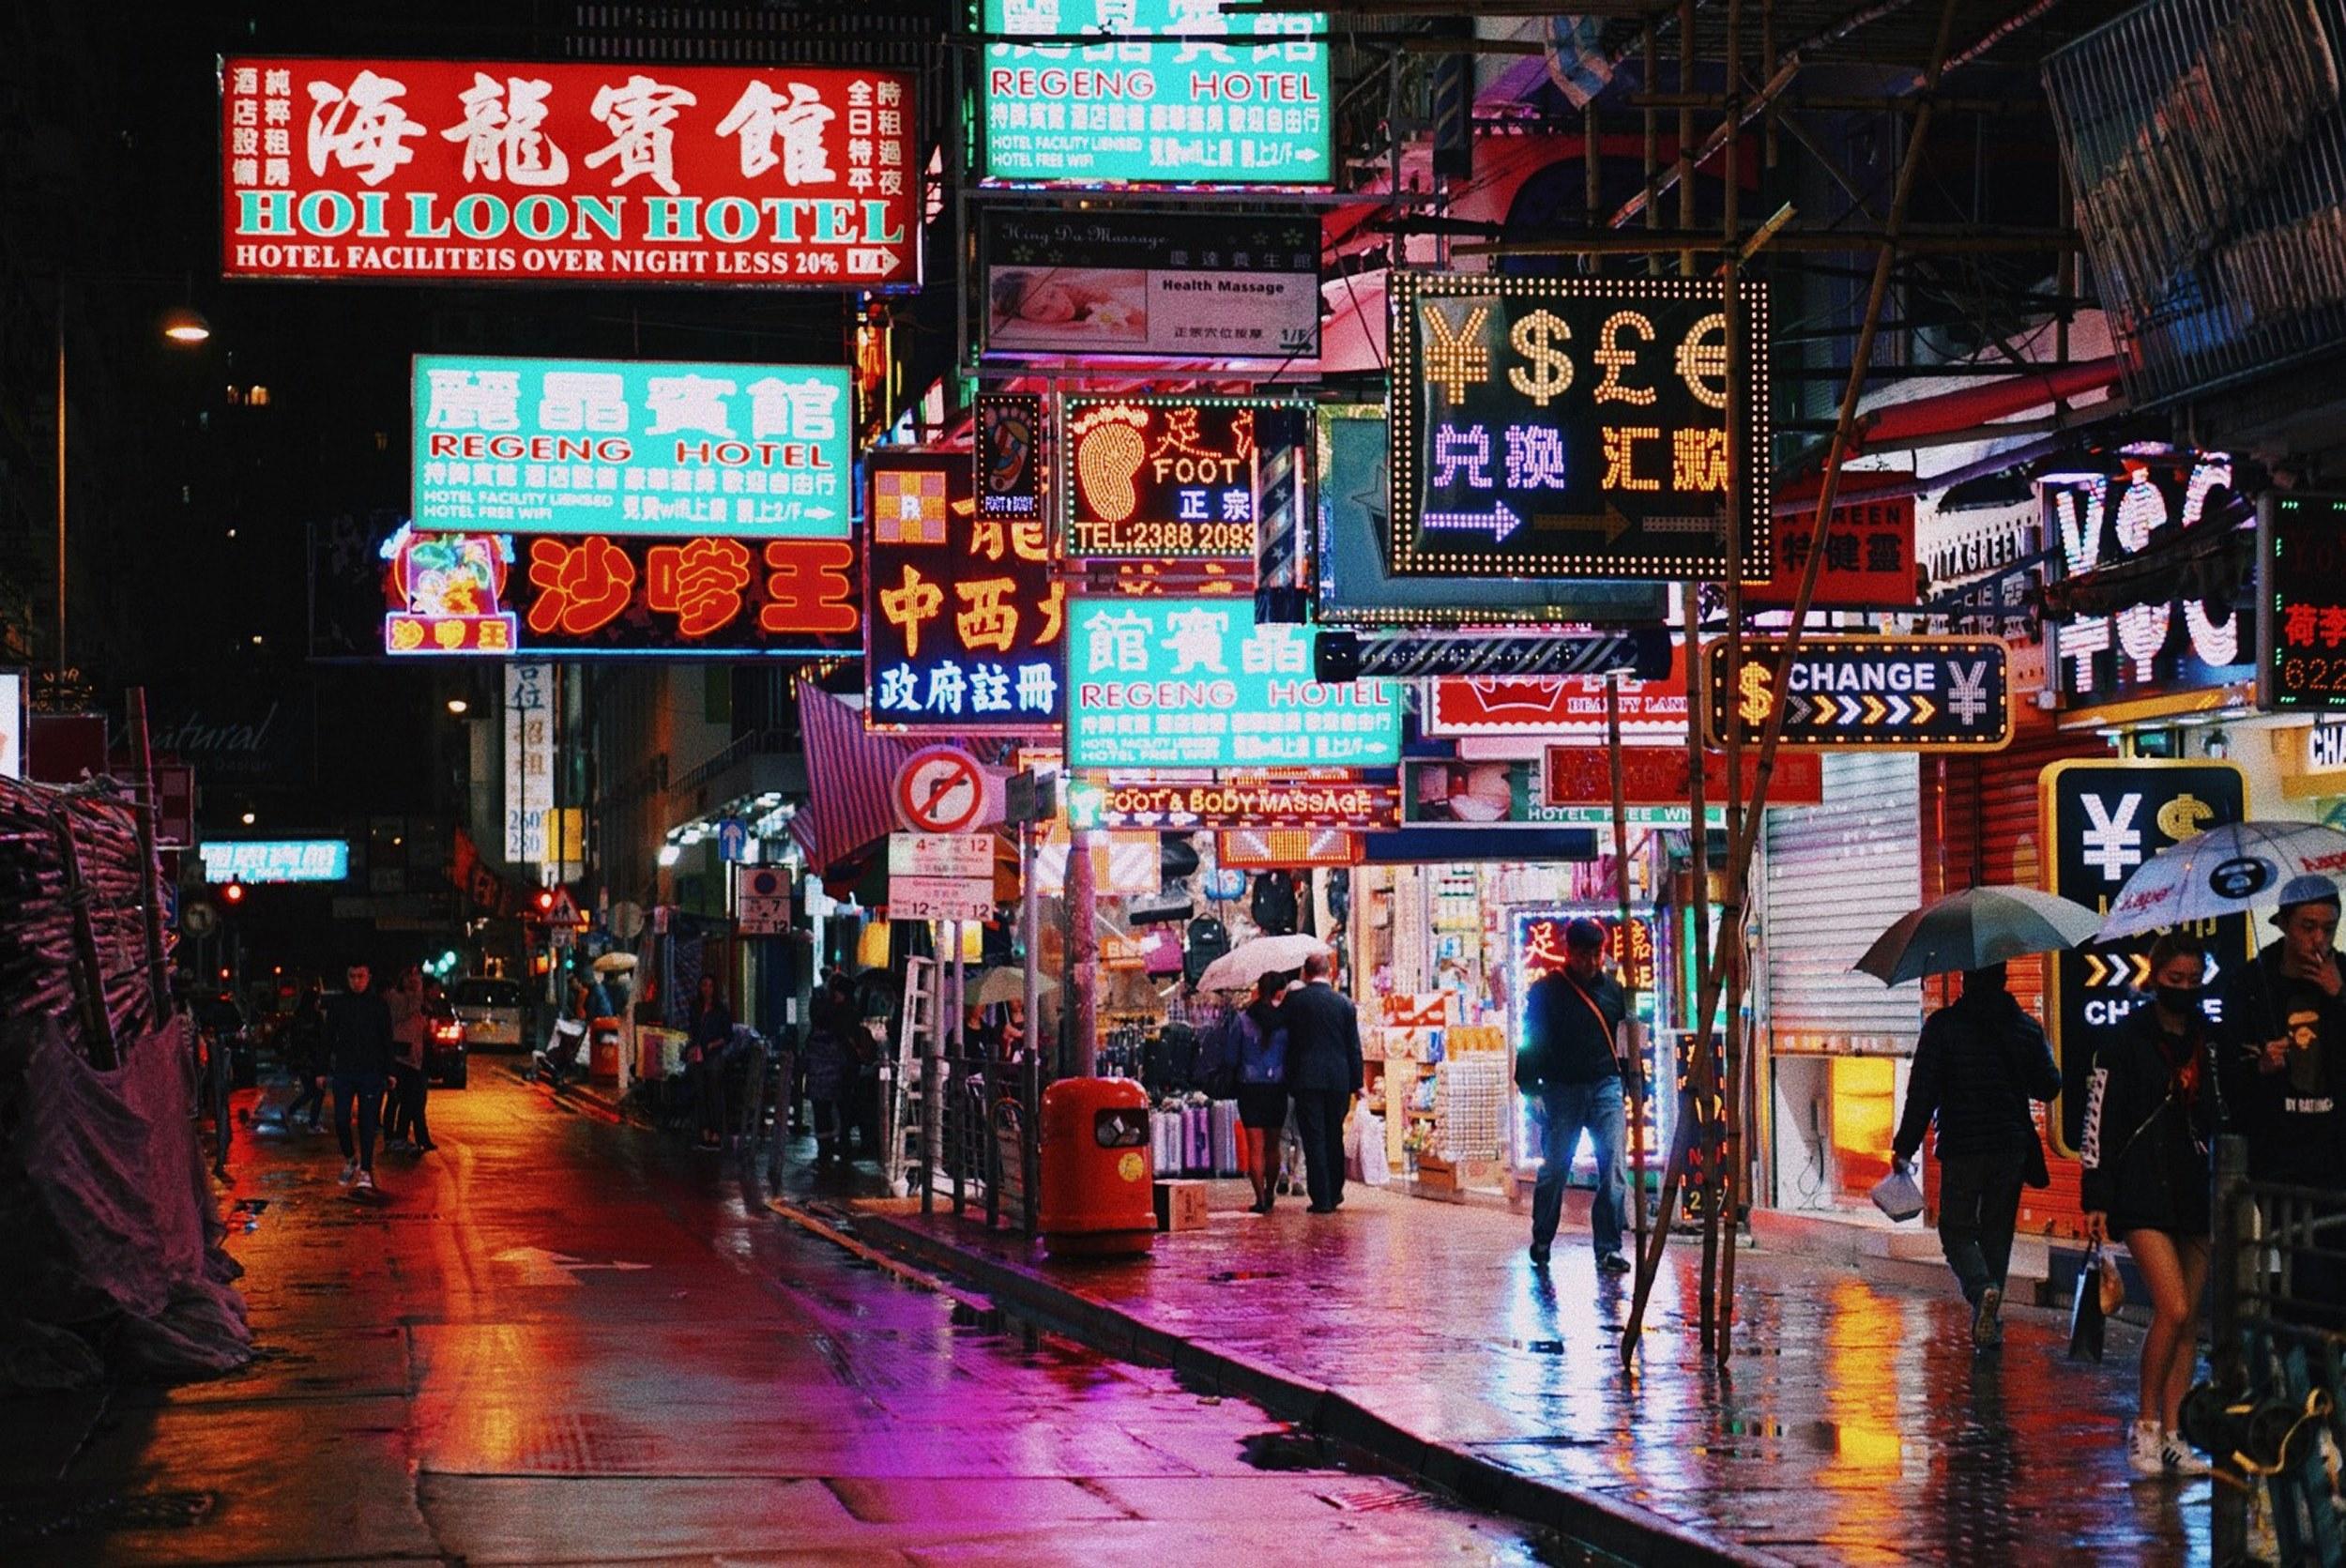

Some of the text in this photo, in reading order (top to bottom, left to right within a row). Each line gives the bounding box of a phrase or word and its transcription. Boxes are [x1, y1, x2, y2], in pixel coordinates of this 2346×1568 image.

[990, 69, 1319, 101] REGENG HOTEL
[307, 69, 837, 194] 海龍賓館
[992, 137, 1032, 151] HOTEL
[992, 154, 1032, 167] HOTEL
[236, 190, 905, 244] HOI LOON HOTEL
[236, 245, 340, 268] HOTEL
[346, 246, 515, 271] FACILITEIS
[523, 249, 604, 272] OVER
[612, 250, 708, 273] NIGHT
[716, 251, 789, 273] LESS
[796, 252, 838, 274] 20%
[1163, 279, 1285, 295] Health Massage
[429, 433, 833, 469] REGENG HOTEL
[1153, 458, 1240, 484] FOOT
[424, 490, 474, 504] HOTEL
[424, 505, 474, 519] HOTEL
[1789, 662, 1935, 692] CHANGE
[1080, 680, 1391, 709] REGENG HOTEL
[1567, 696, 1640, 713] BEATY
[1190, 791, 1254, 814] BODY
[1259, 791, 1372, 816] MASSAGE
[1528, 807, 1591, 821] HOTEL
[971, 840, 987, 853] 12
[973, 904, 989, 918] 12
